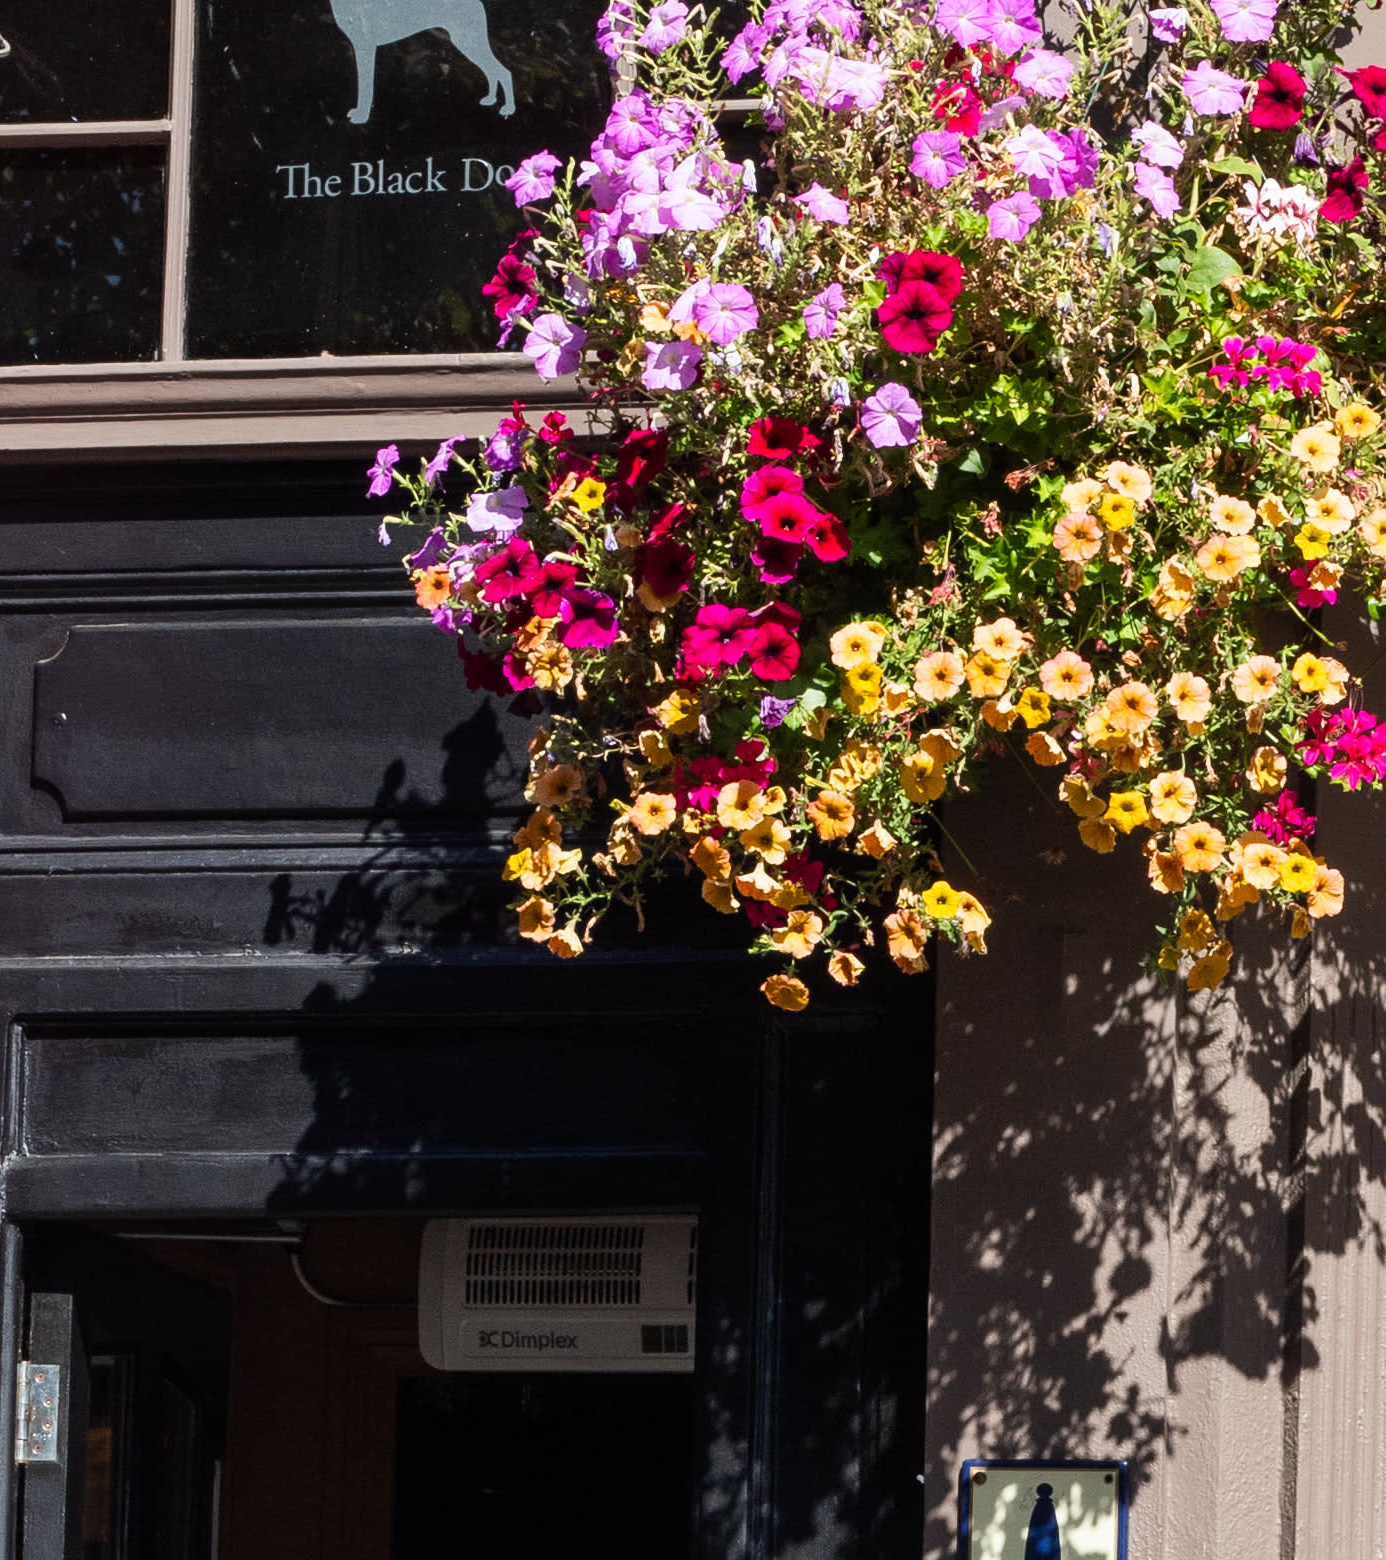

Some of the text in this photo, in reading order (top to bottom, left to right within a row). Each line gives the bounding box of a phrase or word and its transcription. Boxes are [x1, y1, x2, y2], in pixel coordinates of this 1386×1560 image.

[275, 156, 516, 200] The Black Do
[499, 1330, 578, 1351] Dimplex
